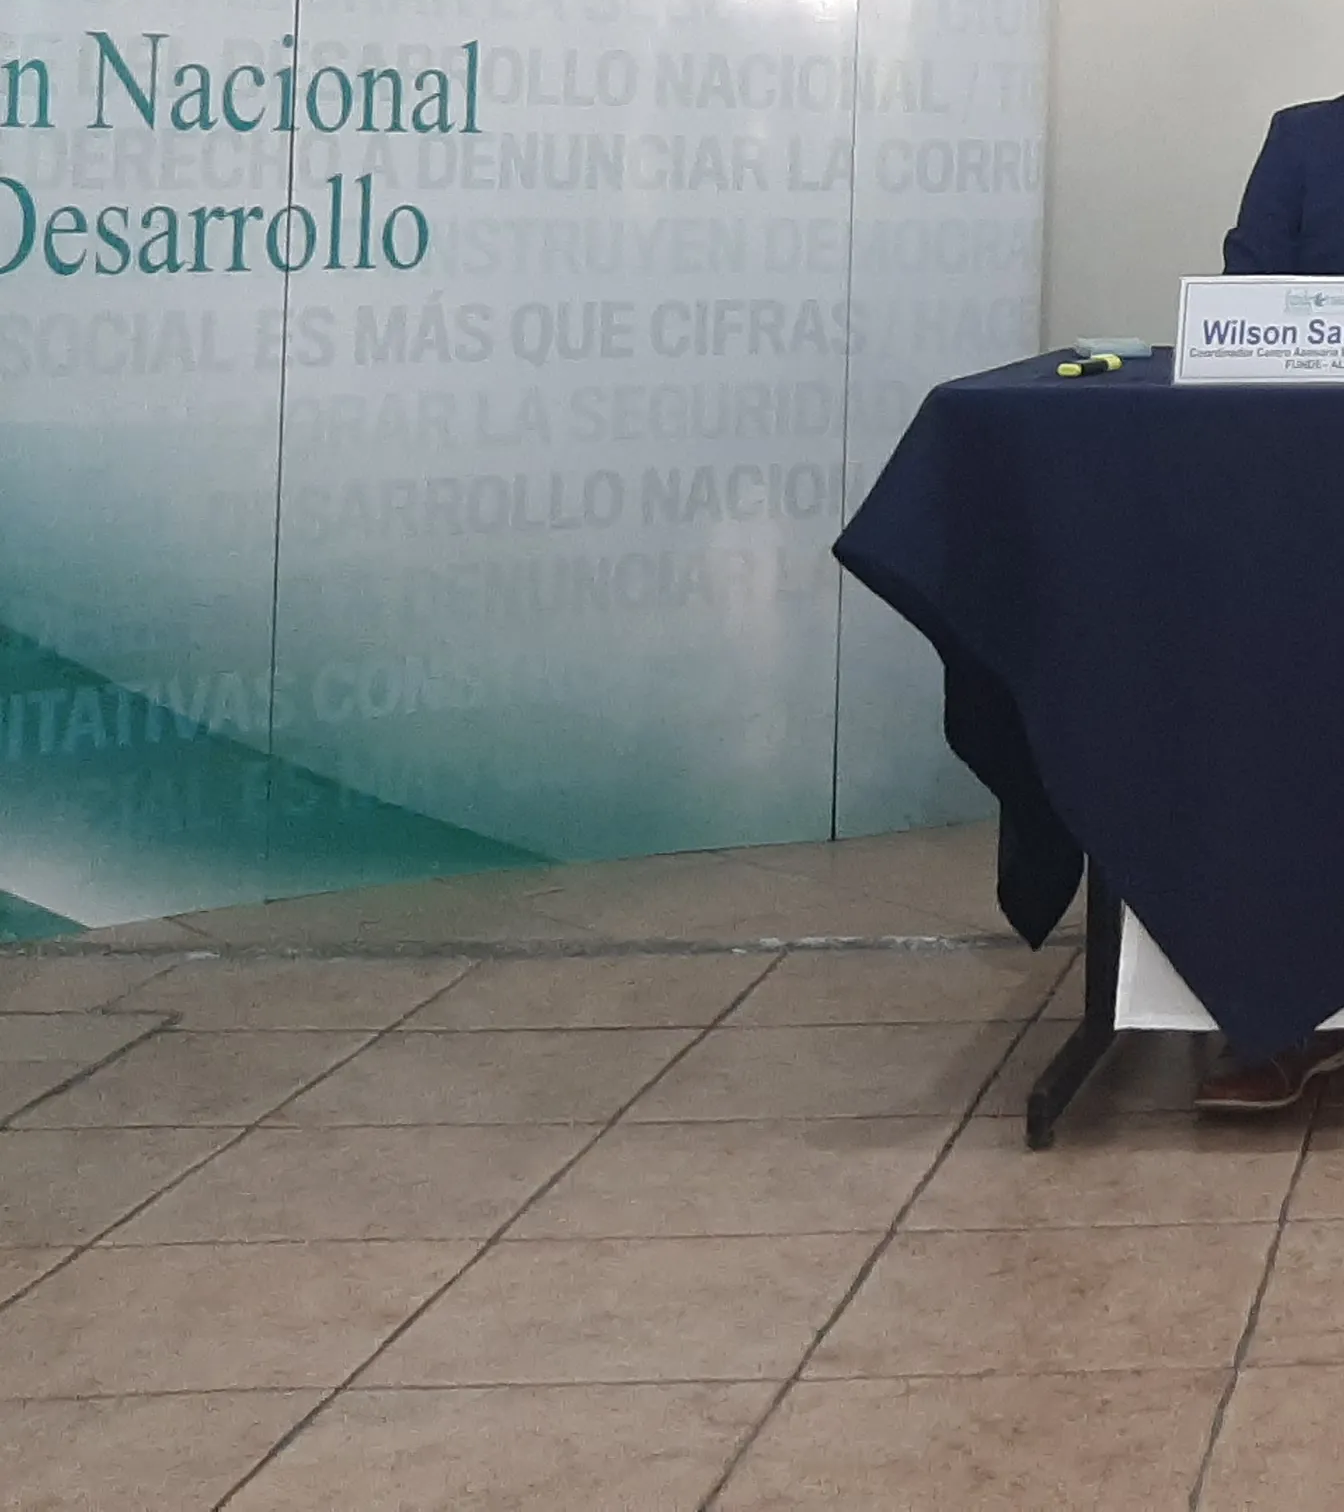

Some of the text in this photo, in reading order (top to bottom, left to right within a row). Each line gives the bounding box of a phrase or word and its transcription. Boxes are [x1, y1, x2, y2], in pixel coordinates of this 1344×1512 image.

[86, 30, 484, 134] Nacional
[652, 50, 951, 115] NACIONAL
[415, 131, 770, 192] DENUNCIAR
[787, 136, 855, 192] LA
[0, 310, 234, 378] SOCIAL
[254, 303, 338, 371] ES
[354, 290, 495, 366] MÁS
[510, 300, 636, 368] QUE
[649, 298, 868, 357] CIFRAS
[1203, 319, 1298, 346] Wilson
